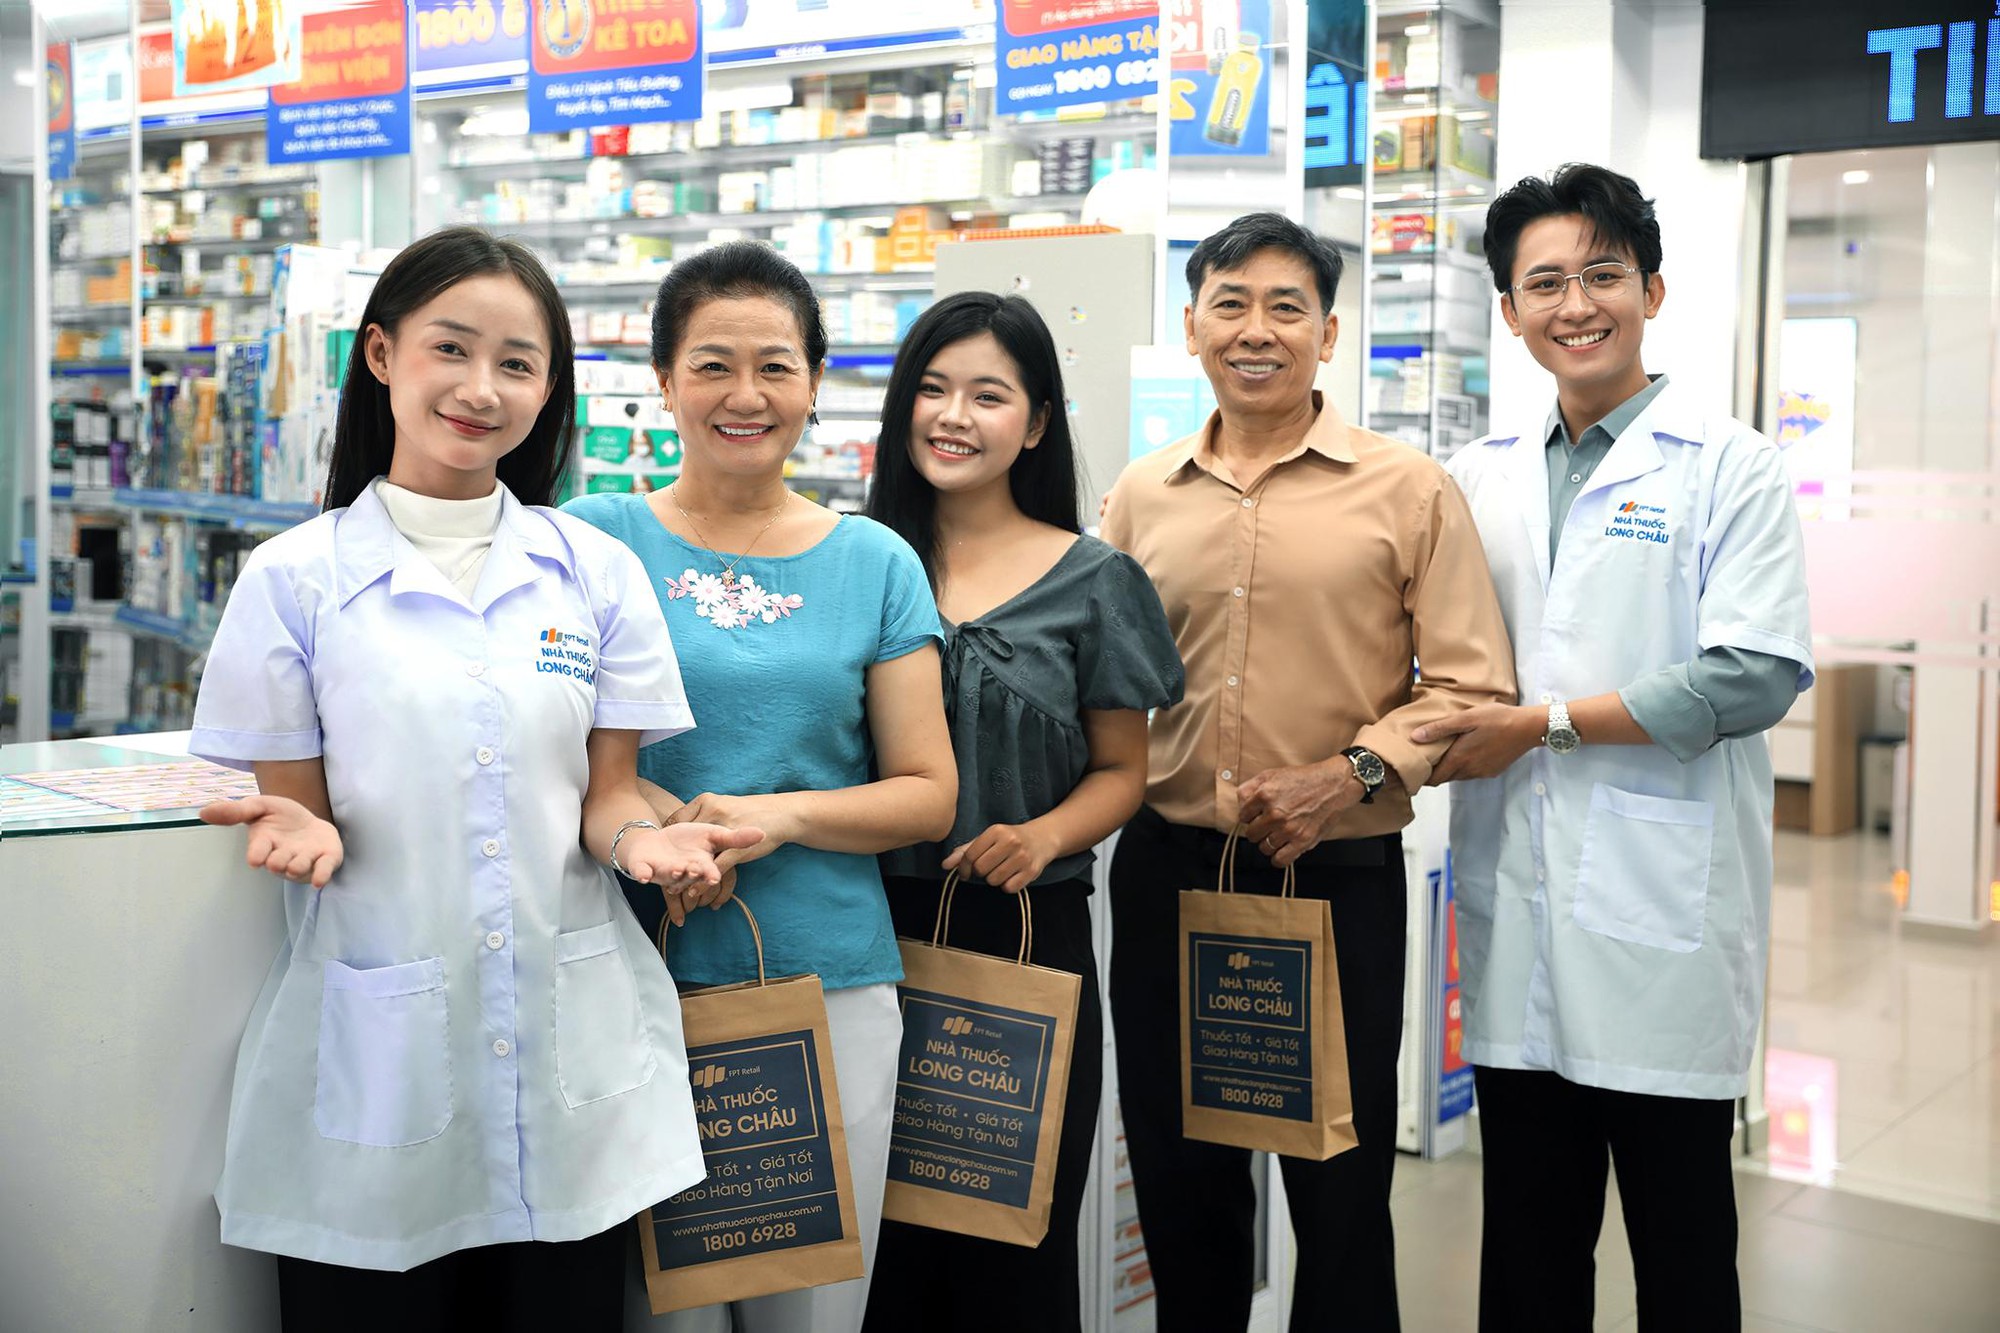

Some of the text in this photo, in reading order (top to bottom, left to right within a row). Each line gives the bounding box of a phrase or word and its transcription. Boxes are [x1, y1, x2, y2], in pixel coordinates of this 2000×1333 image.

[594, 16, 689, 52] KÊ TOA
[1006, 44, 1058, 69] GIAO
[1061, 34, 1124, 61] HÀNG
[1126, 25, 1158, 54] TẬ
[1053, 65, 1112, 94] 1800
[1605, 526, 1669, 544] LONG CHÂU
[1613, 515, 1666, 529] NHÀ THUỐC
[536, 661, 572, 676] LONG
[541, 646, 592, 667] NHÀ THUỐC
[1219, 975, 1283, 993] NHÀ THUỐC
[1209, 994, 1292, 1017] LONG CHÂU
[926, 1039, 1011, 1068] NHÀ THUỐC
[1200, 1029, 1300, 1051] Thuốc Tốt Giá Tốt
[1202, 1045, 1299, 1067] Giao Hàng Tận Nơi
[728, 1066, 761, 1077] FPT Retail
[908, 1056, 1021, 1094] LONG CHÂU
[694, 1084, 779, 1113] HÀ THUỐC
[1221, 1087, 1284, 1109] 1800 6928
[697, 1106, 798, 1140] NG CHÂU
[893, 1111, 1019, 1148] Giao Hàng Tận Nơi
[936, 1102, 958, 1118] Tốt
[975, 1111, 999, 1127] Giá
[1002, 1117, 1024, 1133] Tốt
[713, 1160, 739, 1178] Tốt
[759, 1154, 785, 1171] Giá
[788, 1149, 814, 1164] Tốt
[908, 1159, 991, 1190] 1800 6928
[709, 1181, 752, 1198] Hàng
[754, 1174, 785, 1193] Tận
[787, 1168, 814, 1184] Nơi
[672, 1203, 823, 1237] www.nhathuoclongchau.com.vn
[702, 1222, 797, 1252] 1800 6928
